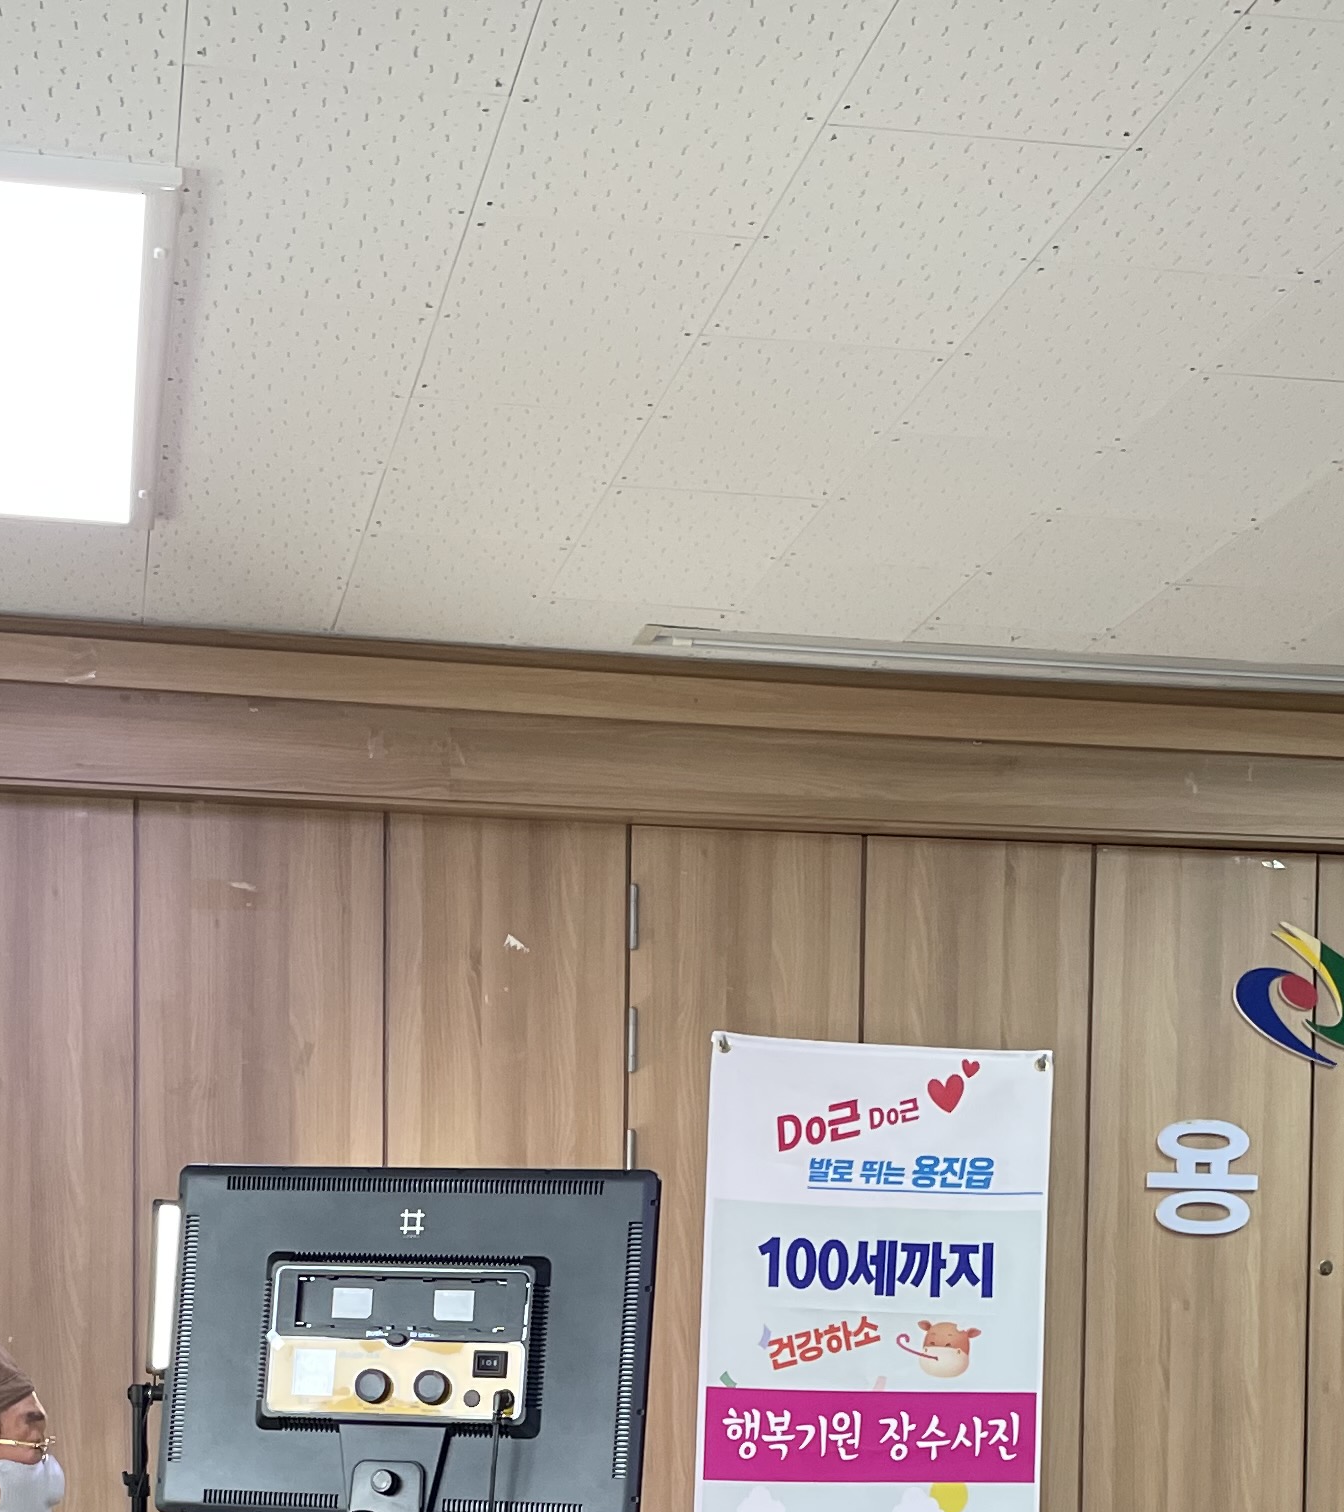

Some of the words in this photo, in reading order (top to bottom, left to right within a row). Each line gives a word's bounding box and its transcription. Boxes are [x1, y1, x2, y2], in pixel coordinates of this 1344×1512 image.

[808, 1157, 855, 1183] 발로
[859, 1160, 906, 1186] 뛰는
[911, 1154, 996, 1190] 용진읍
[758, 1236, 995, 1299] 100세까지
[768, 1315, 882, 1370] 건강하소
[722, 1407, 863, 1461] 행복기원
[878, 1409, 1021, 1462] 장수사진
